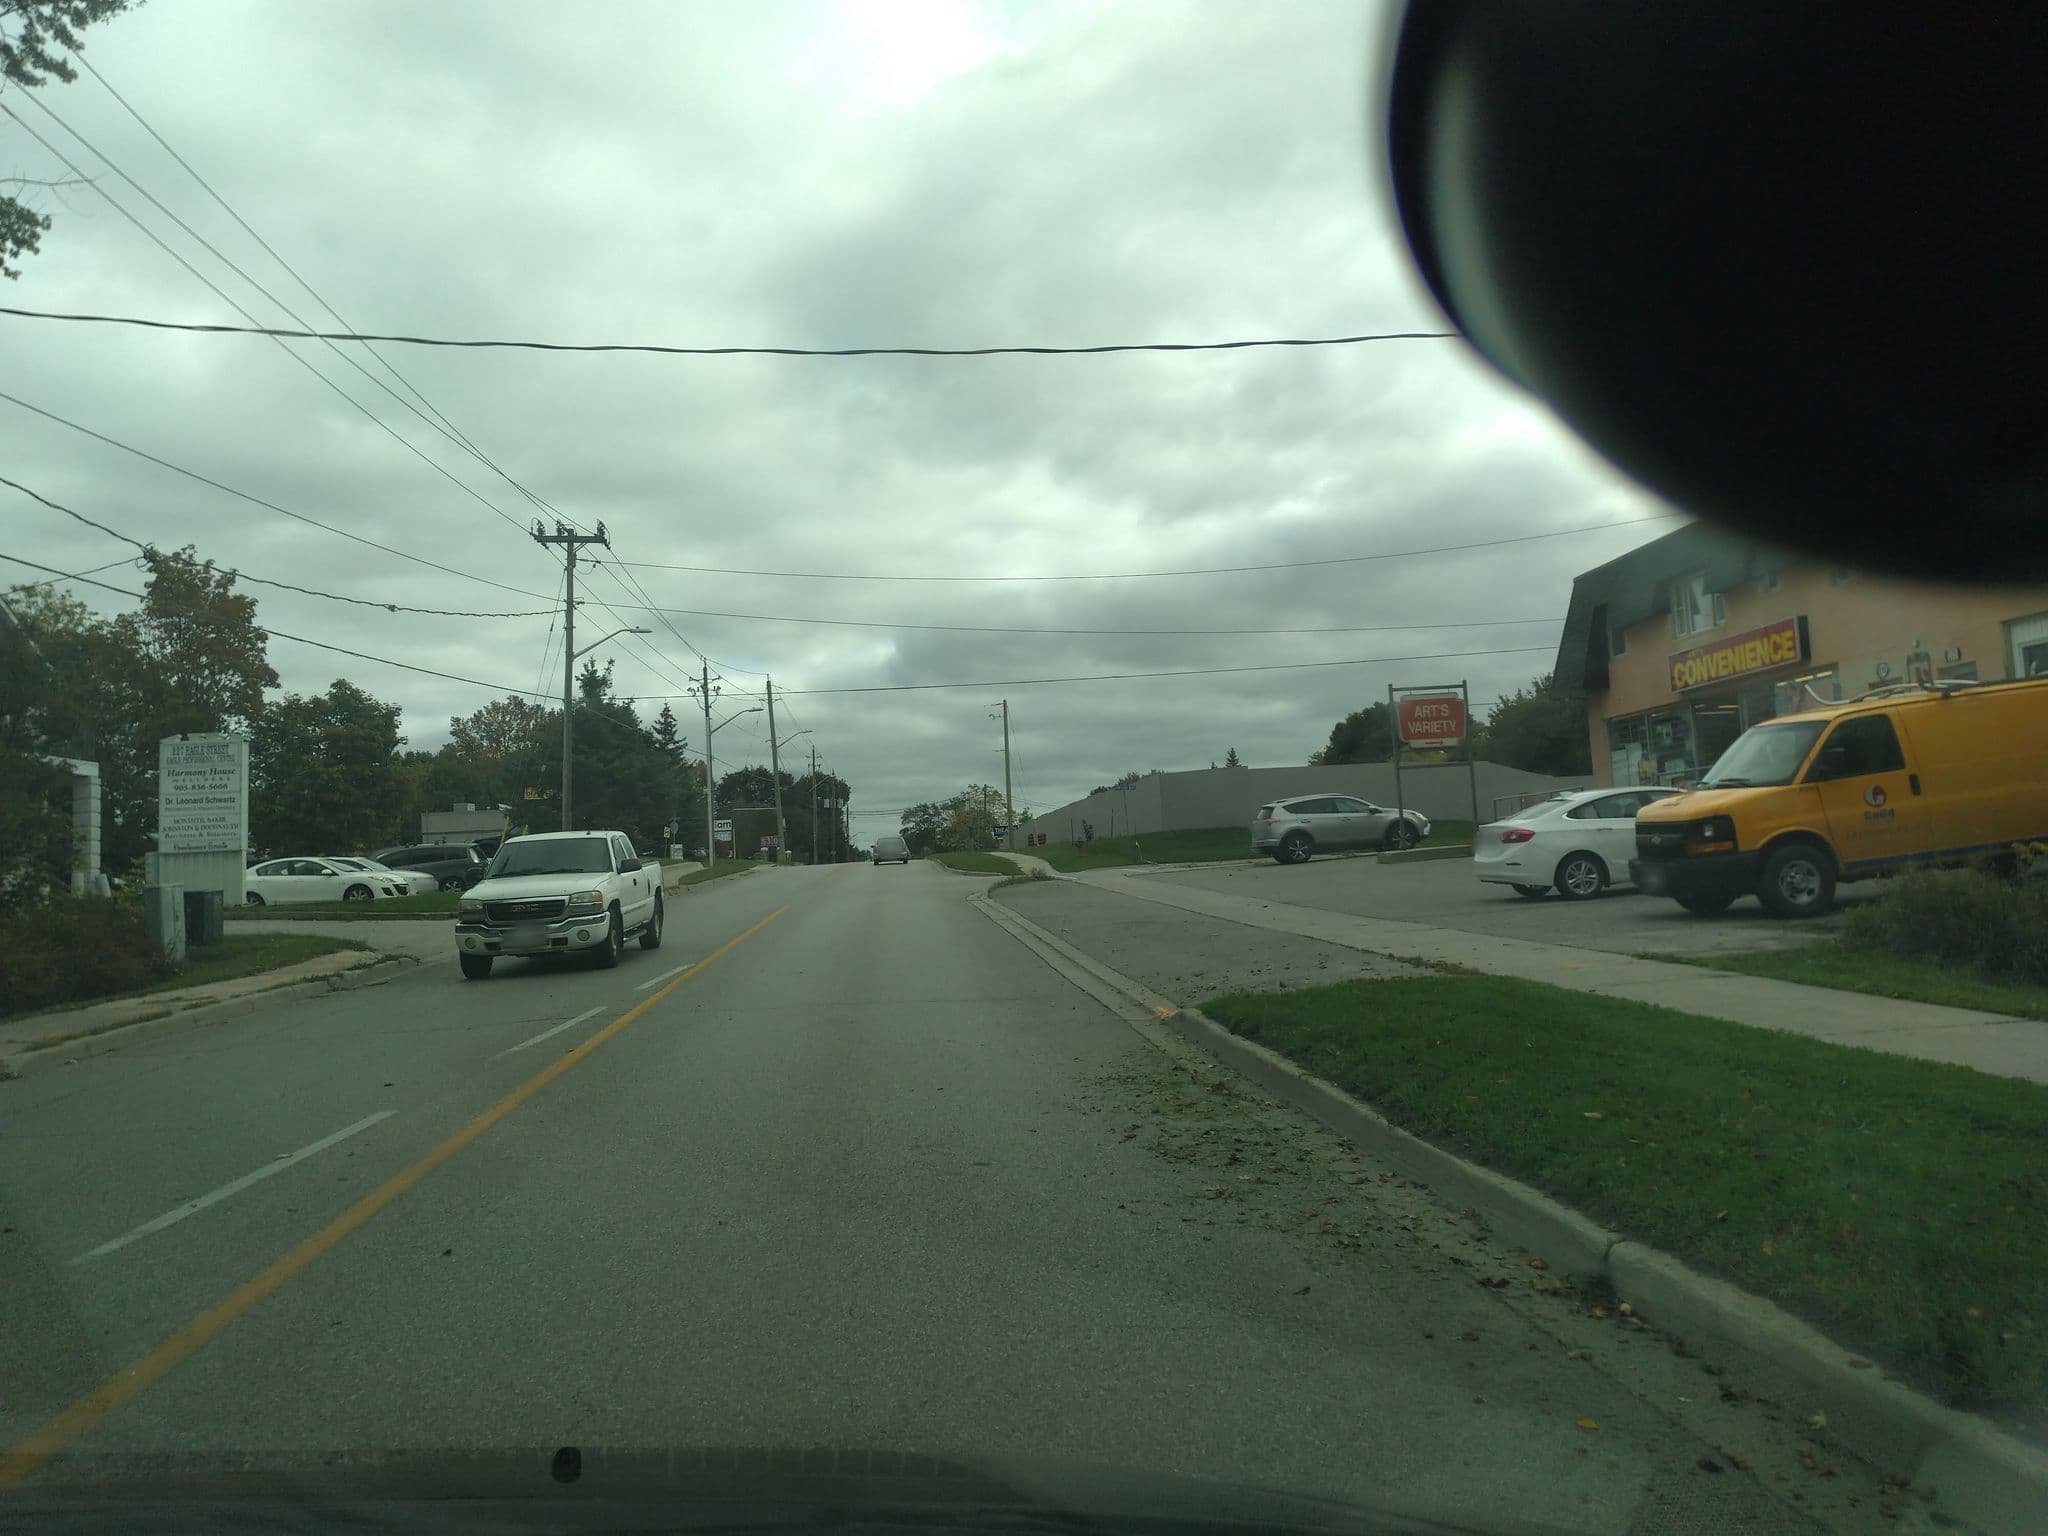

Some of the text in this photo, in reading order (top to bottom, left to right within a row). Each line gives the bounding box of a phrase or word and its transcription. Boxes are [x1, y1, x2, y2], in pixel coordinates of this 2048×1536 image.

[1674, 630, 1795, 688] CONVENIENCE
[1414, 703, 1450, 719] ART'S
[1407, 719, 1457, 734] VARIETY
[167, 767, 236, 778] Harmony House
[176, 796, 204, 805] Leonard
[205, 795, 236, 804] Schwartz
[511, 903, 541, 913] GMC
